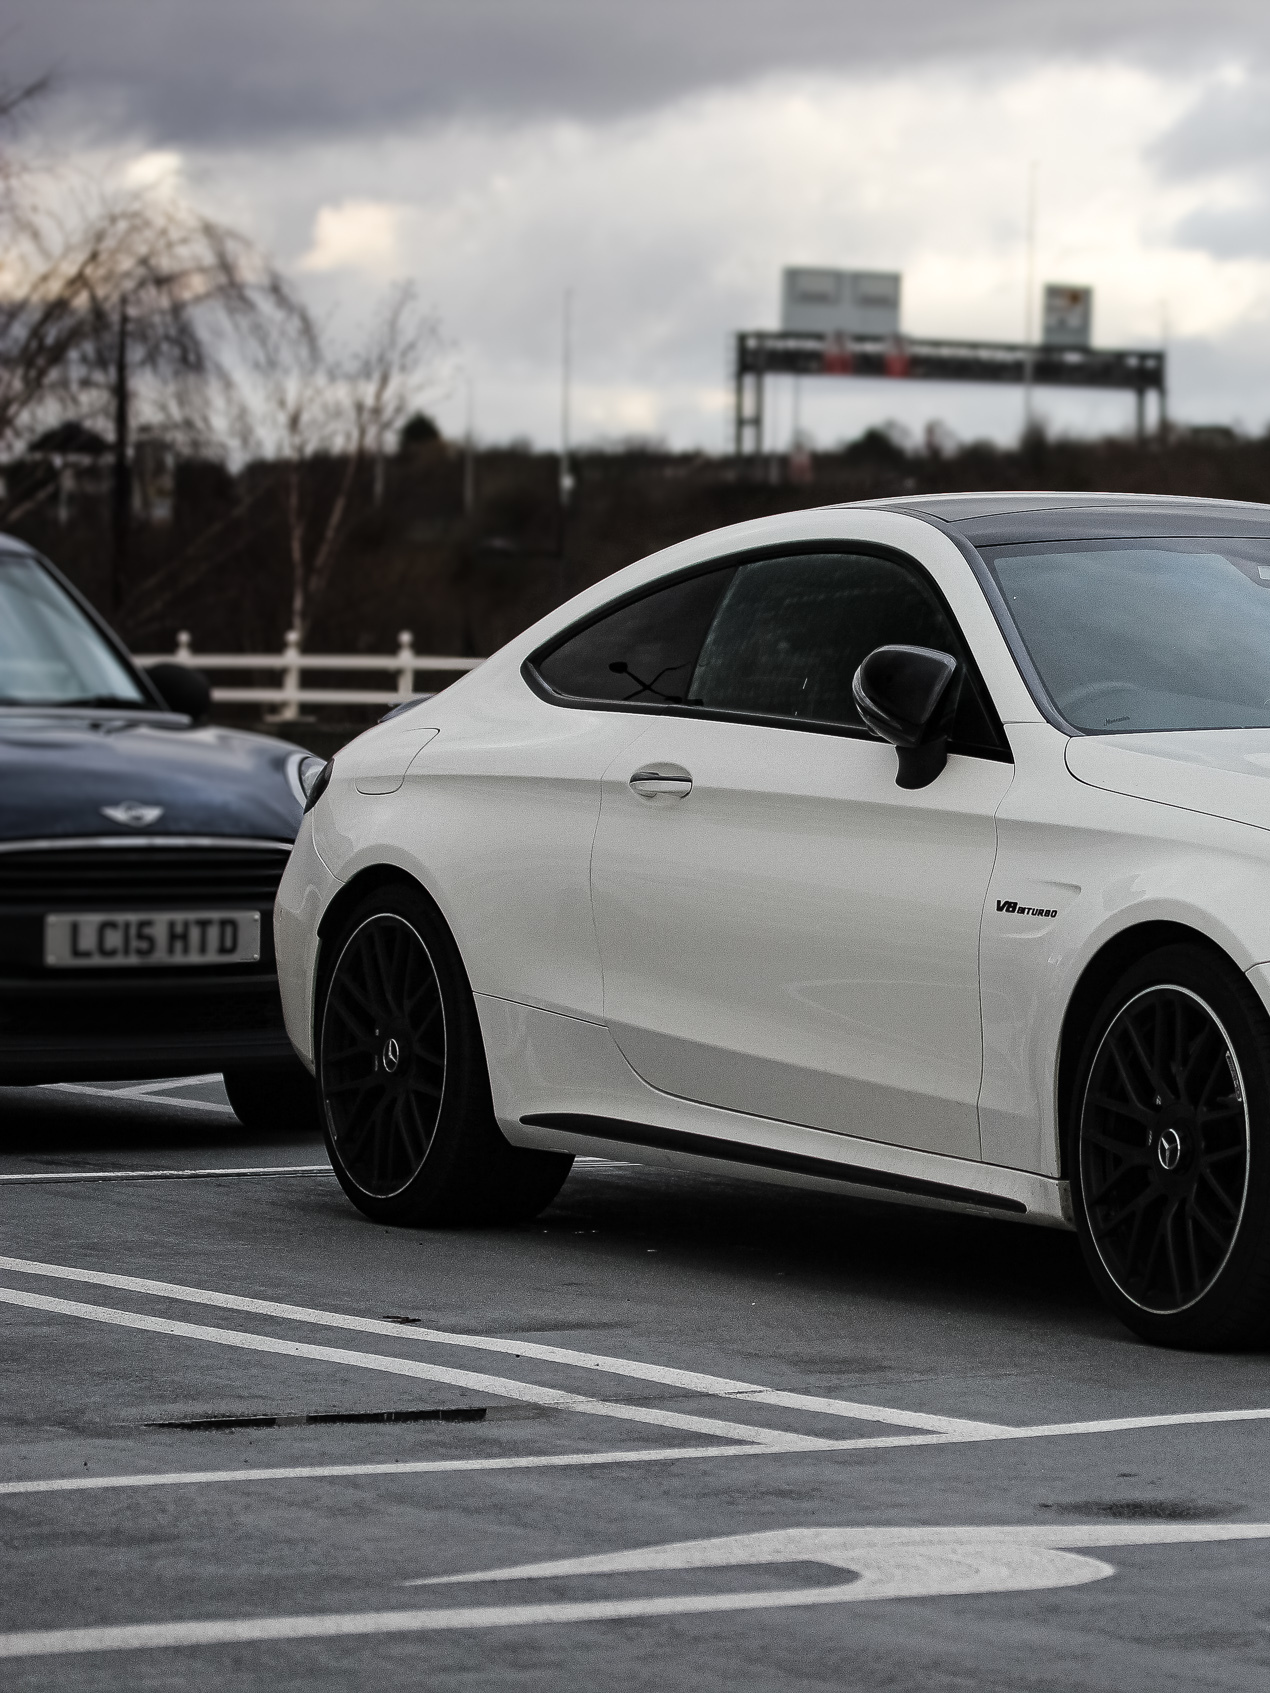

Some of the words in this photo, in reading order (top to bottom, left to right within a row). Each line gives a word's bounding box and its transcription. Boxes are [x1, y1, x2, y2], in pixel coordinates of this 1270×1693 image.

[996, 900, 1018, 914] V8
[1017, 906, 1058, 918] BITURBO
[70, 919, 155, 958] LC15
[167, 917, 239, 955] HTD
